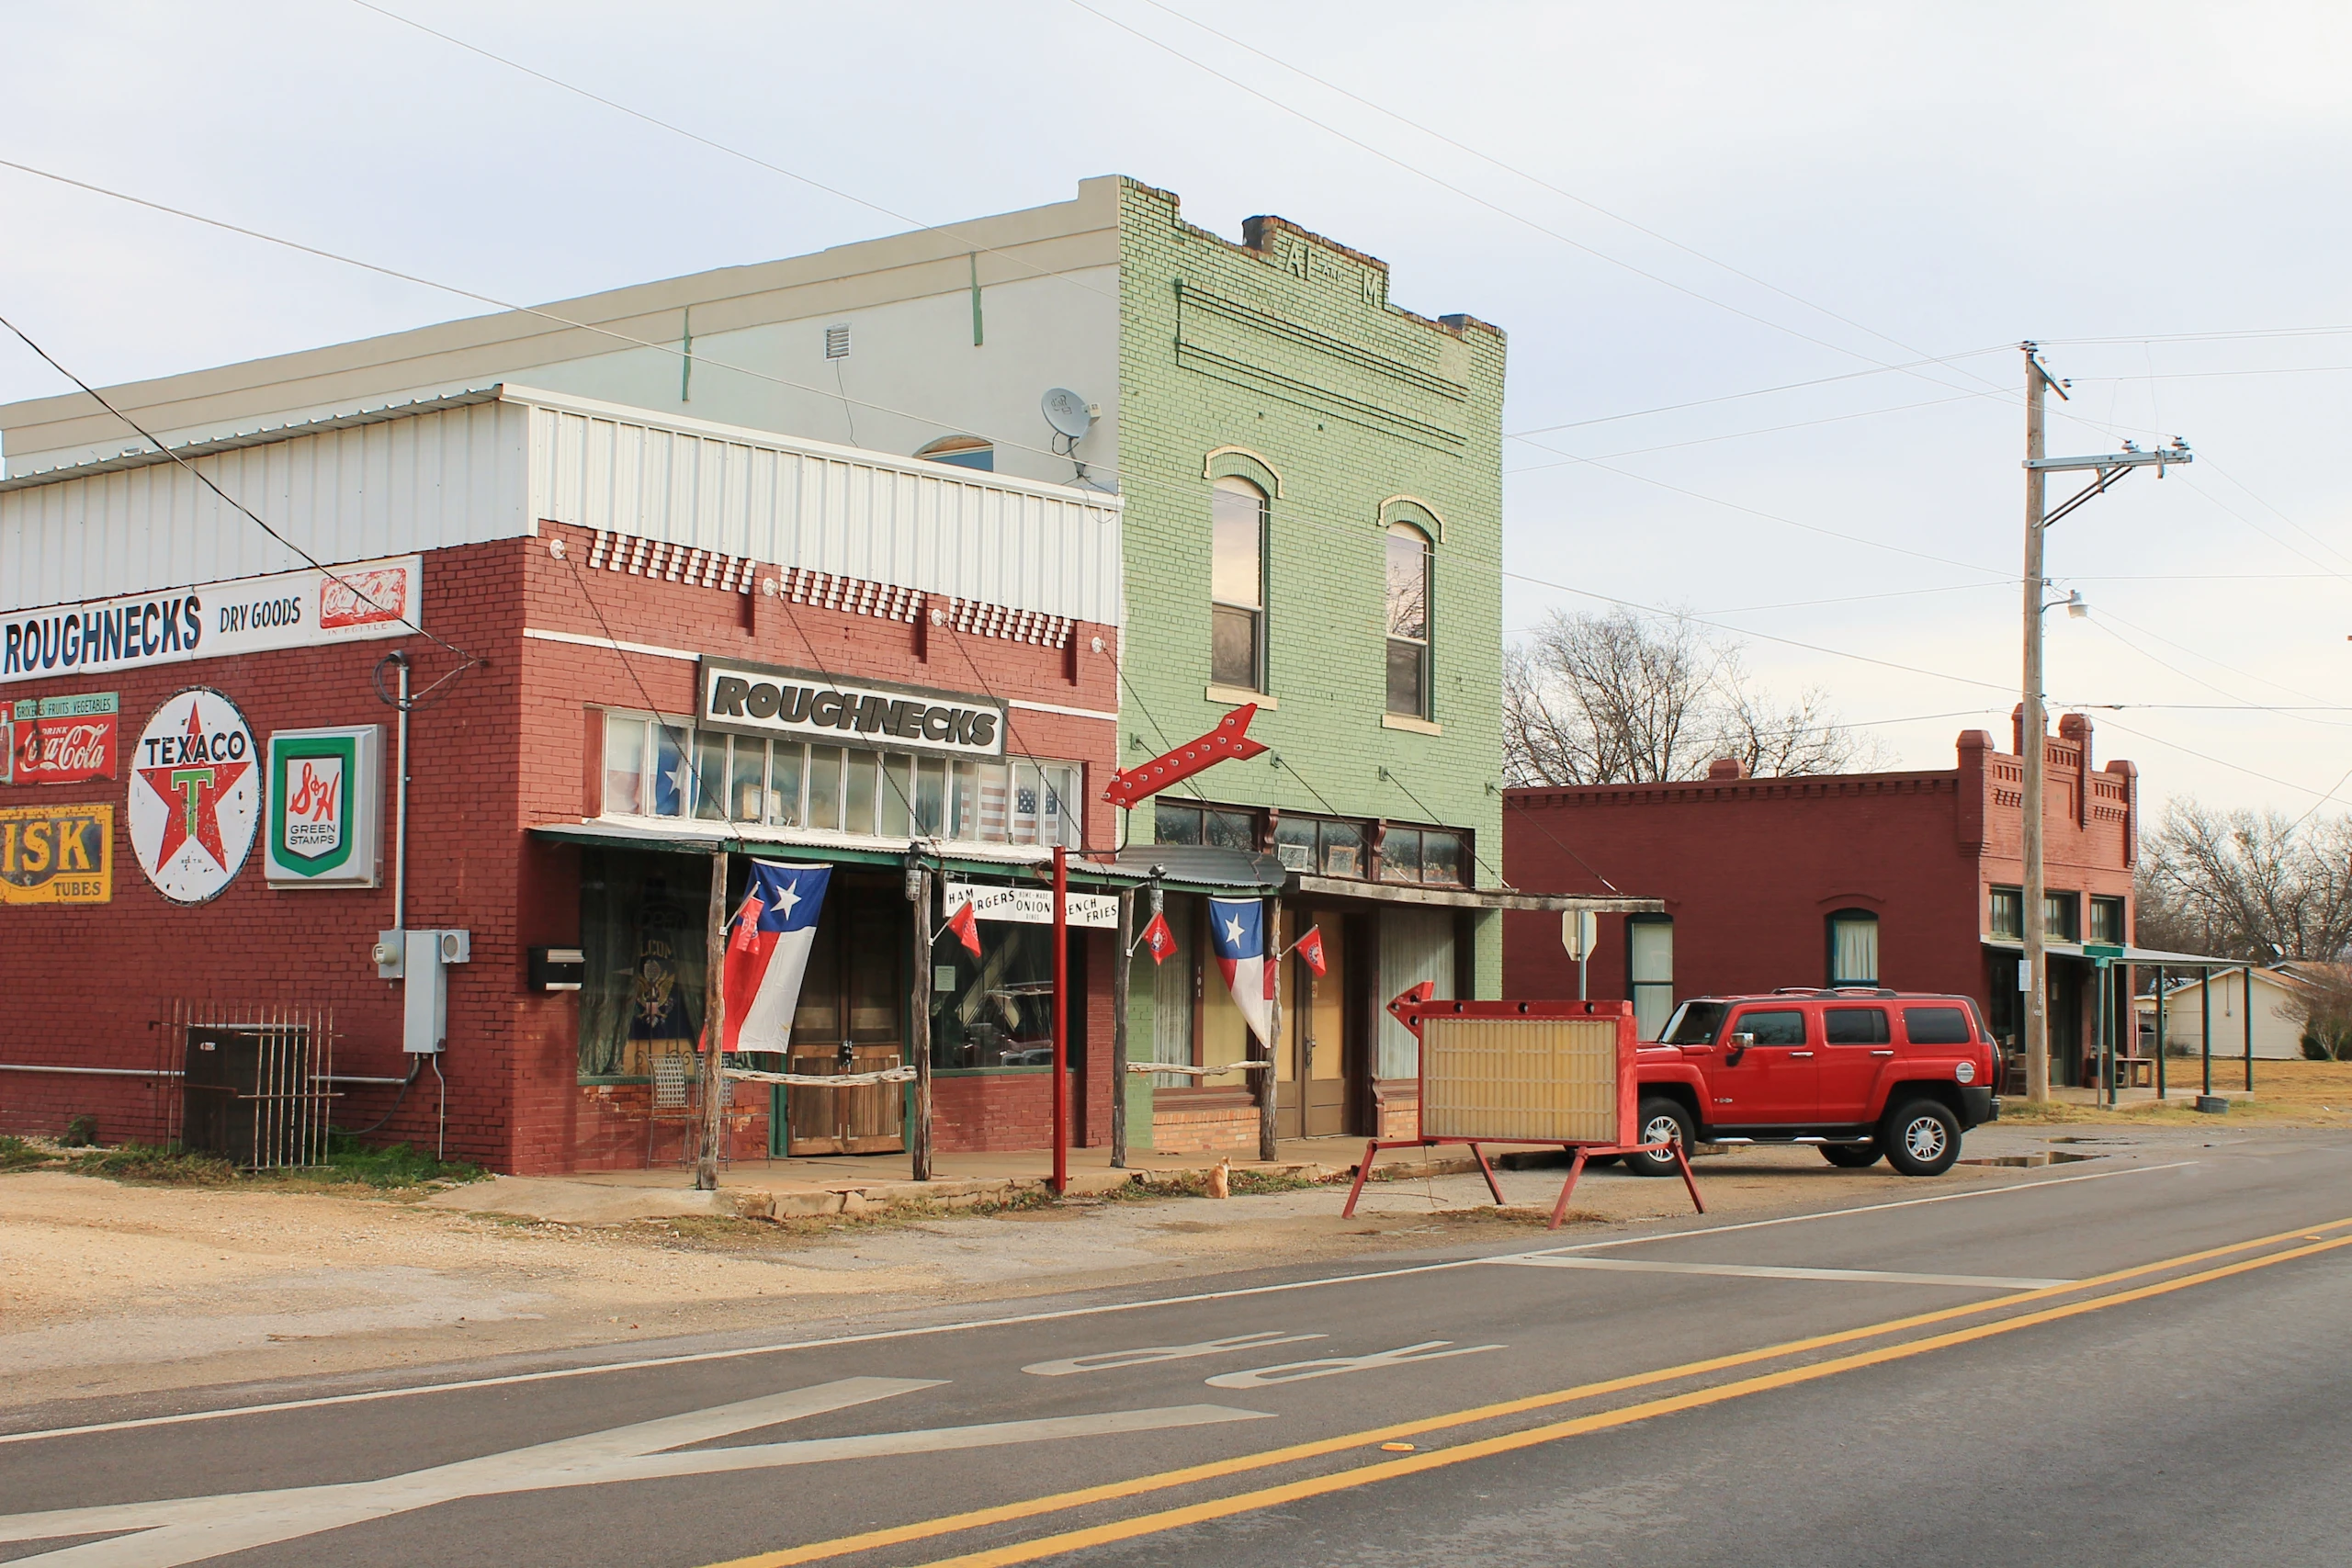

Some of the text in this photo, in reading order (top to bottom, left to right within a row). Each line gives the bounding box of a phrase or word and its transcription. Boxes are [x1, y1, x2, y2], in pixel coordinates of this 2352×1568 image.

[1323, 264, 1342, 281] AND
[1363, 269, 1378, 307] M
[4, 595, 301, 674] ROUGHNECKS DRY GOODS
[49, 702, 69, 715] FRUITS
[74, 698, 111, 714] VEGETABLES
[712, 676, 997, 746] ROUGHNECKS
[42, 726, 69, 735] DRINK
[145, 731, 246, 766] TEXACO
[289, 761, 340, 822] S&H
[171, 768, 215, 838] T
[290, 824, 336, 834] GREEN
[290, 835, 335, 845] STAMPS
[53, 881, 101, 897] TUBES
[949, 887, 974, 905] HAM
[972, 890, 1015, 913] URGERS
[1016, 900, 1051, 913] ONION
[1065, 897, 1097, 916] ENCH
[1086, 905, 1117, 922] FRIES
